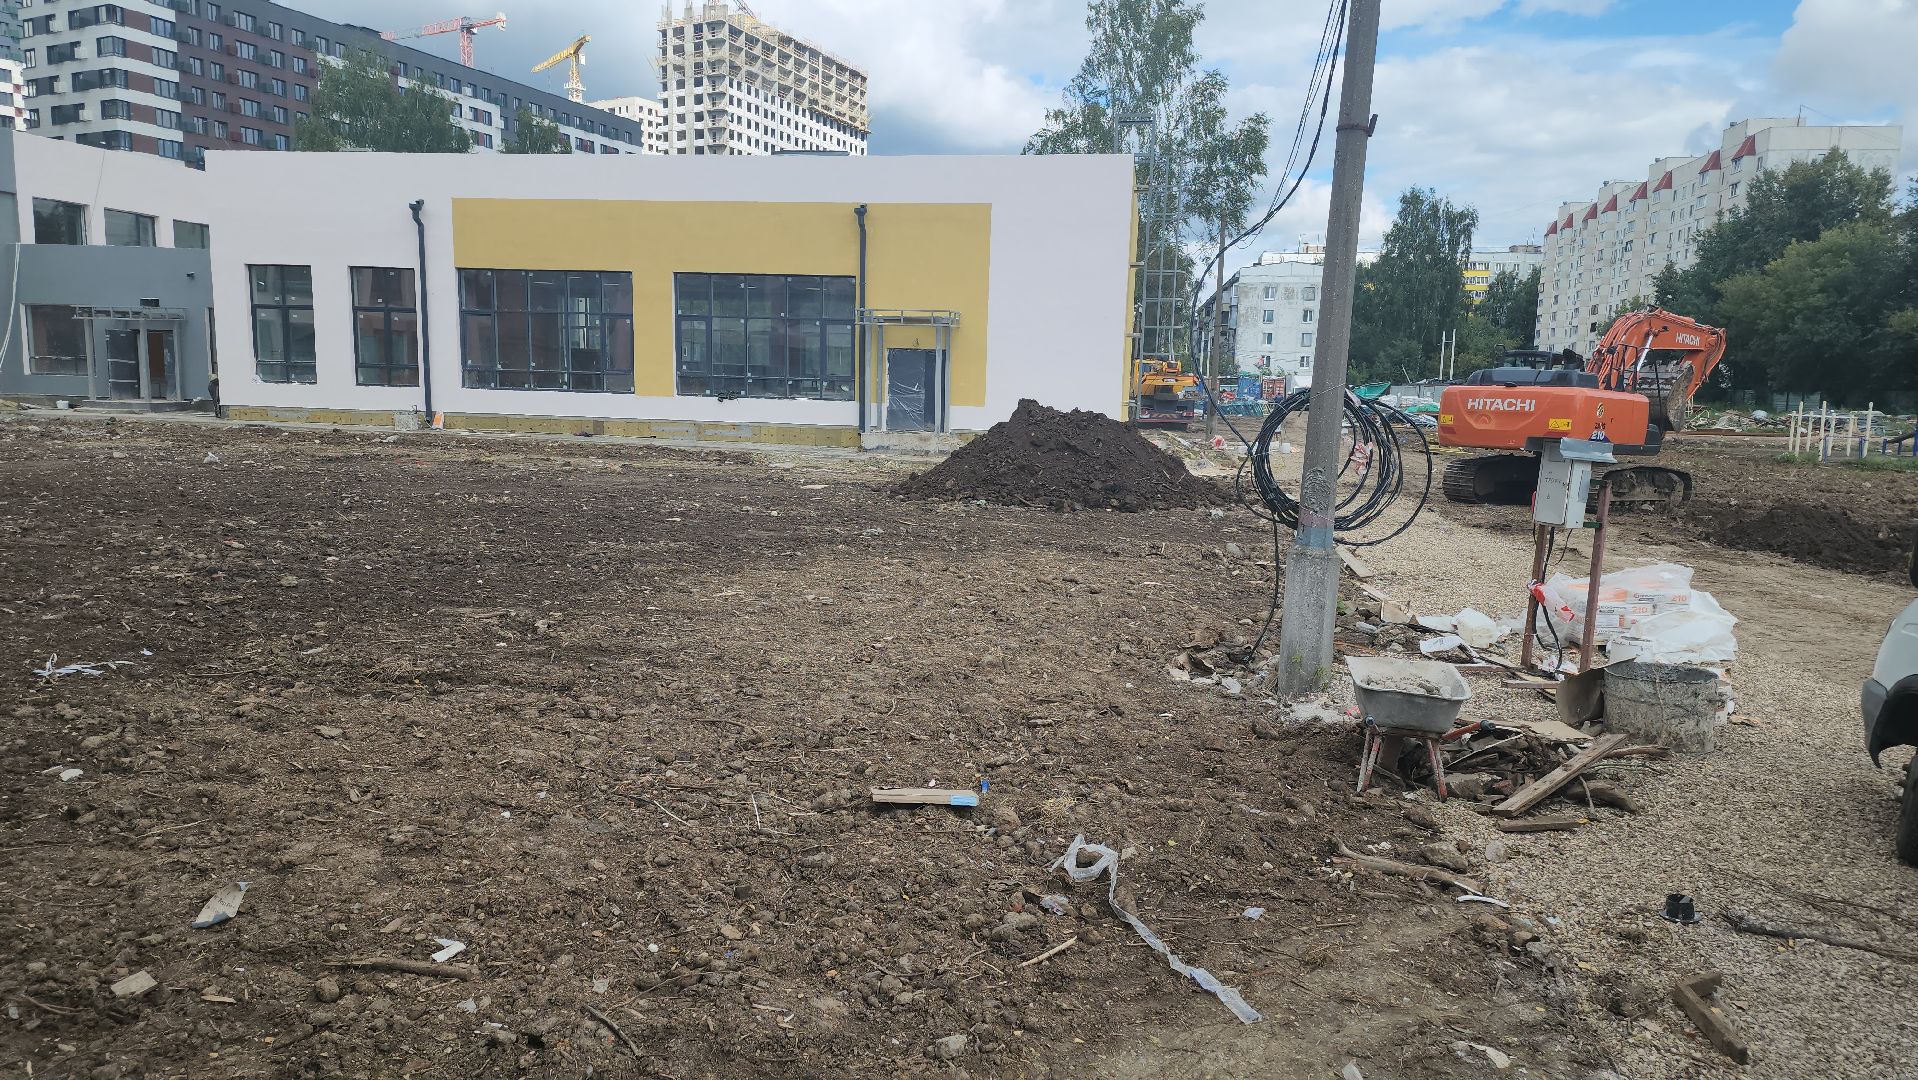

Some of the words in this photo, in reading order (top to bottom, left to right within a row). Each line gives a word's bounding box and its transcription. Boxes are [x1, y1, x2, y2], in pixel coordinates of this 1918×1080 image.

[1676, 332, 1701, 347] HITACHI
[1467, 398, 1536, 412] HITACHI
[1591, 430, 1605, 441] 210
[1671, 594, 1688, 602] 210
[1631, 606, 1648, 614] 210
